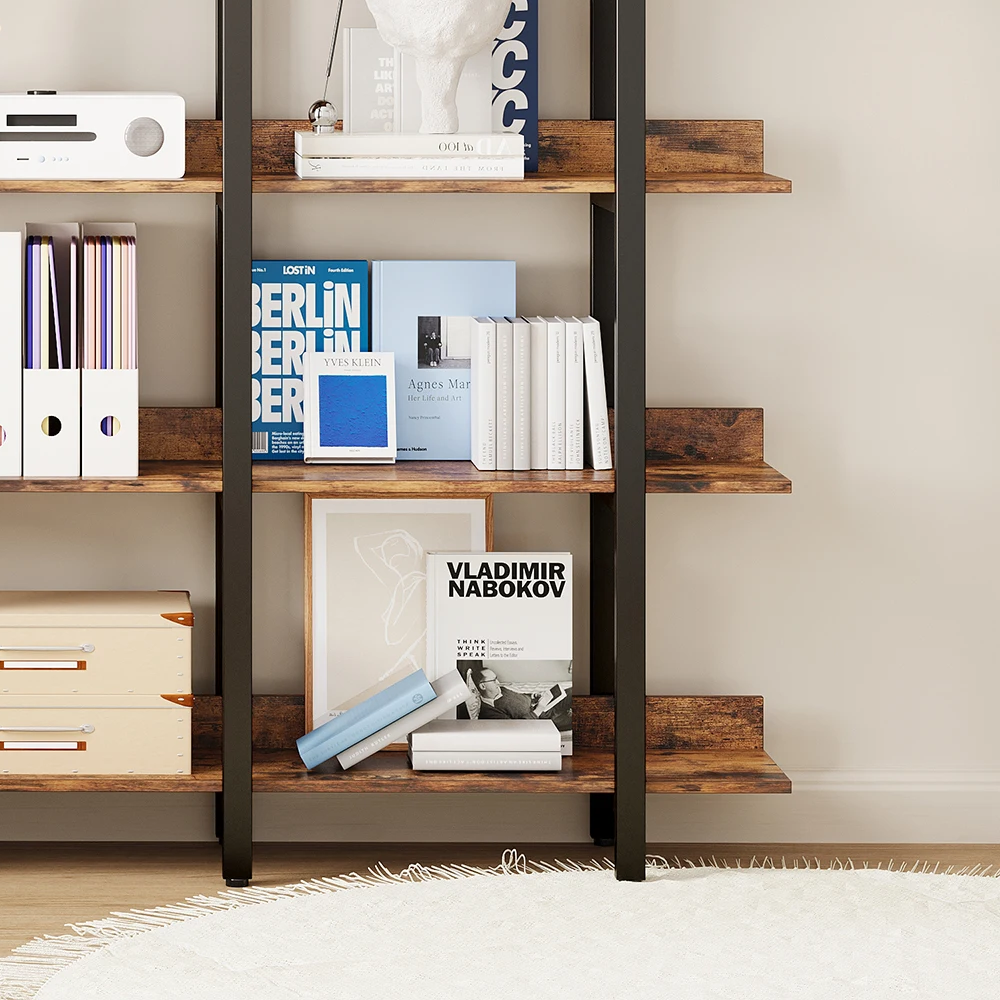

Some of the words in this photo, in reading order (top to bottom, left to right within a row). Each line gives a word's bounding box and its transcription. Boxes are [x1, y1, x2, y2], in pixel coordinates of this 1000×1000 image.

[324, 358, 349, 367] YVES
[351, 358, 381, 367] KLEIN
[408, 378, 444, 392] Agnes
[448, 378, 471, 389] Mar
[603, 437, 608, 445] ON
[446, 561, 566, 579] VLADIMIR
[448, 580, 566, 598] NABOKOV
